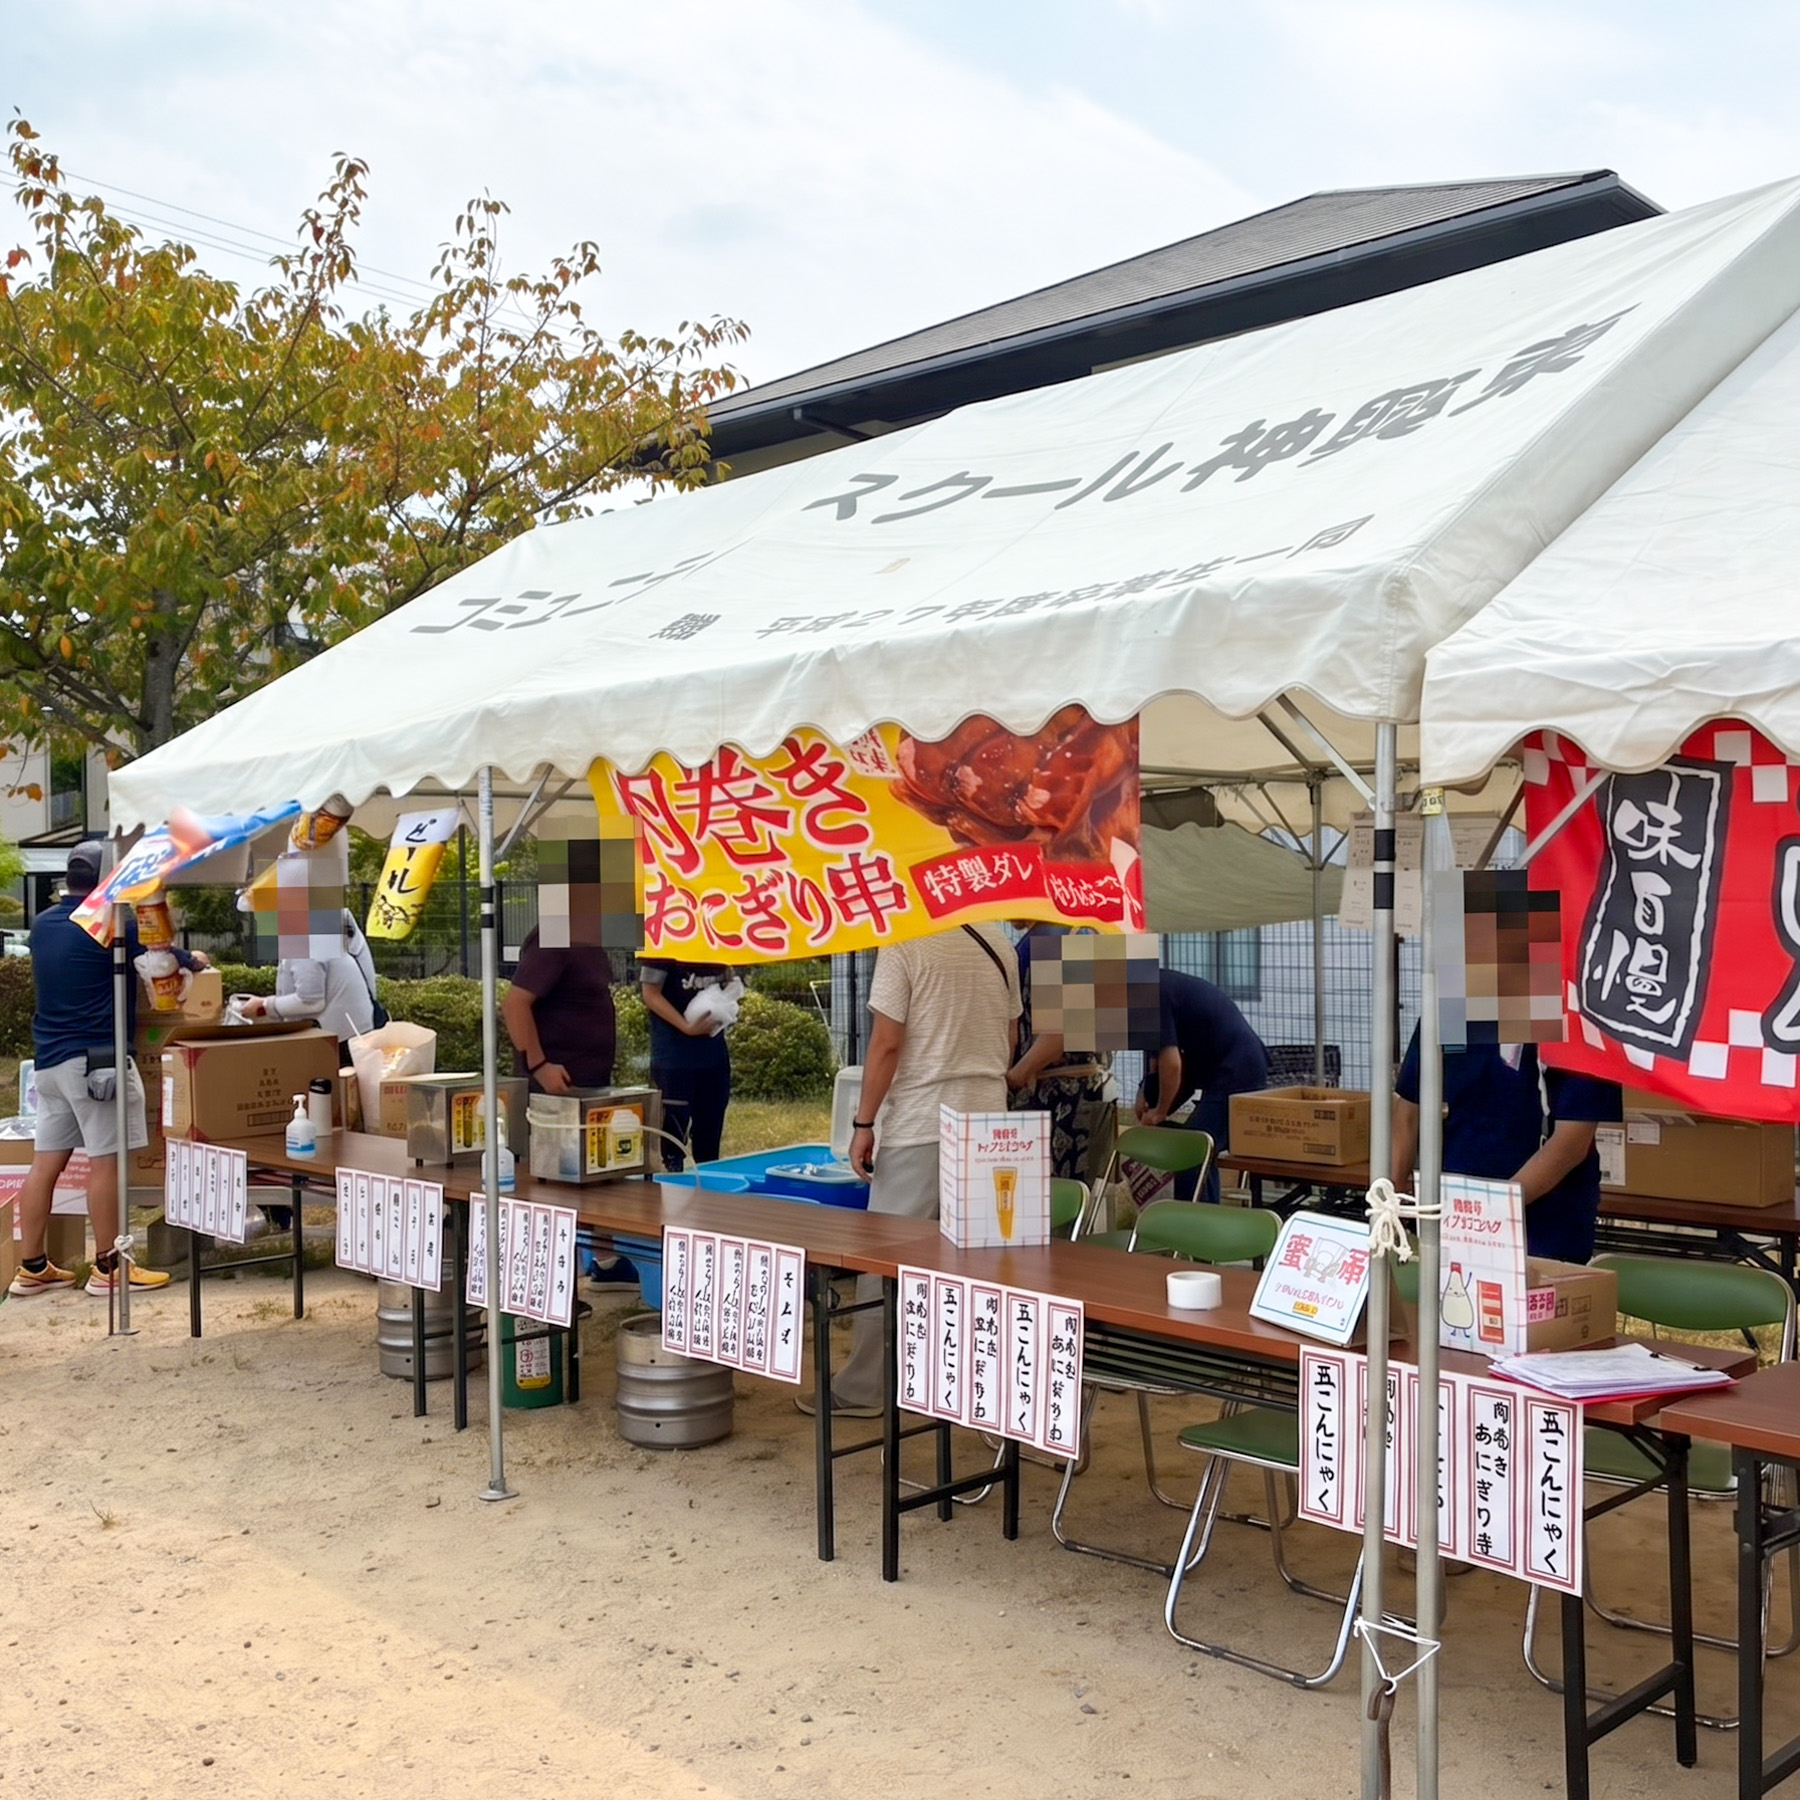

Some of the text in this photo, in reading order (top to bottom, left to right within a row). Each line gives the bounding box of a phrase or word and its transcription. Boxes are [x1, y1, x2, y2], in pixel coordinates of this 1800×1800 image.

[645, 852, 907, 949] おにぎり串
